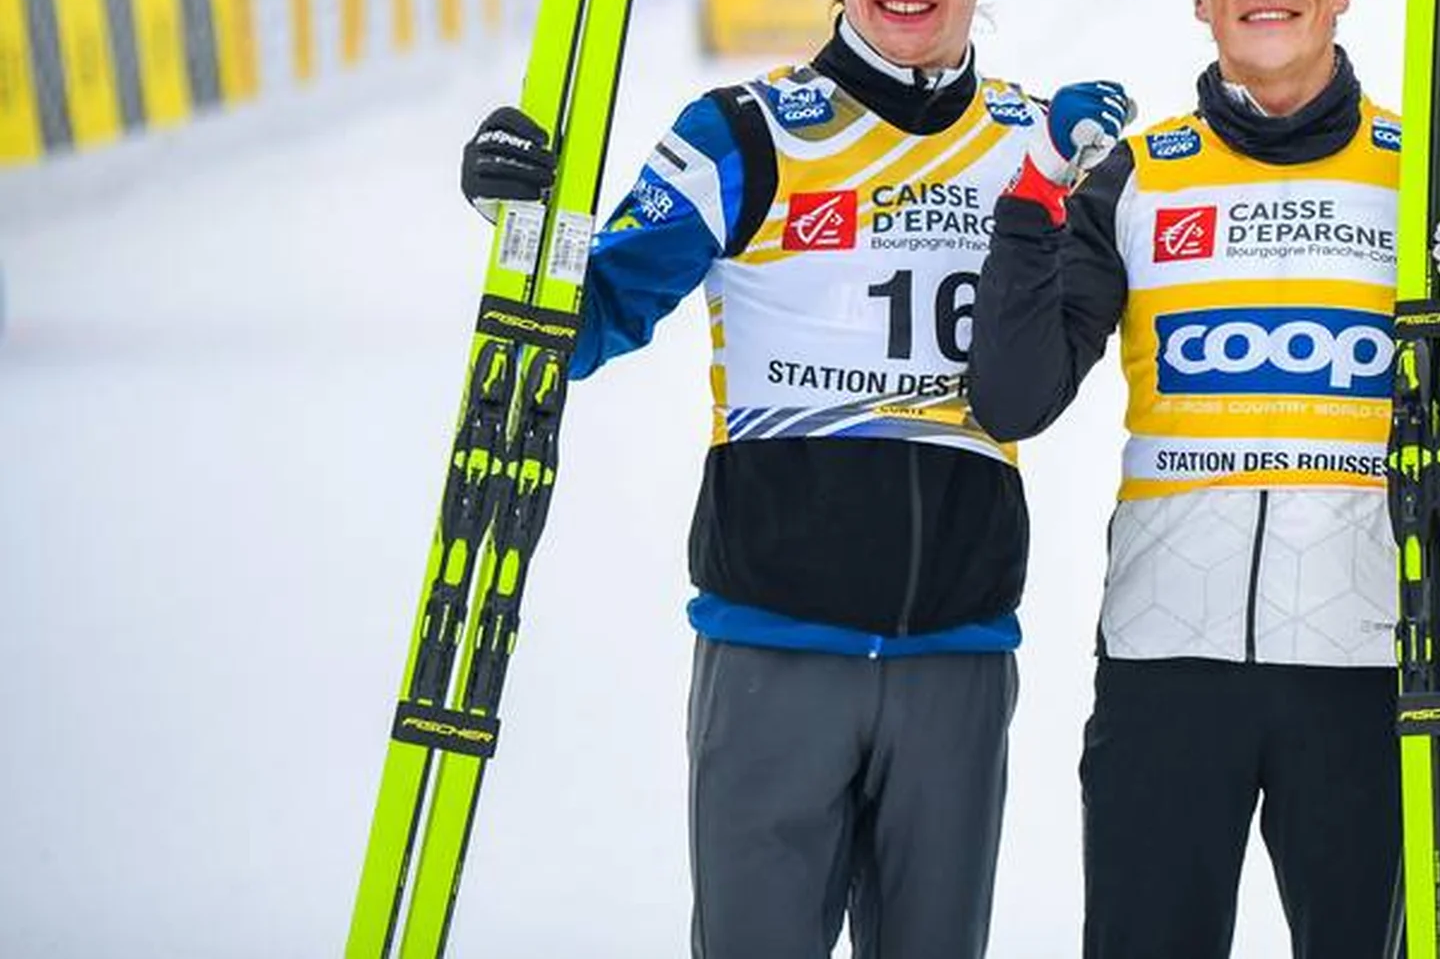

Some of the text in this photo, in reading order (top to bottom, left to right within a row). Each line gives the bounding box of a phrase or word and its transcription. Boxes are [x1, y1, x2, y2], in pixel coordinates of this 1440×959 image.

[872, 183, 980, 209] CAISSE
[1229, 200, 1335, 222] CAISSE
[1228, 223, 1394, 251] D'EPARGNE
[483, 310, 577, 338] FISCHER
[868, 270, 981, 363] 16
[1164, 321, 1395, 388] coop
[768, 360, 887, 394] STATION
[897, 373, 949, 397] DES
[1156, 450, 1235, 472] STATION
[1244, 452, 1289, 472] DES
[403, 717, 494, 742] FISCHER
